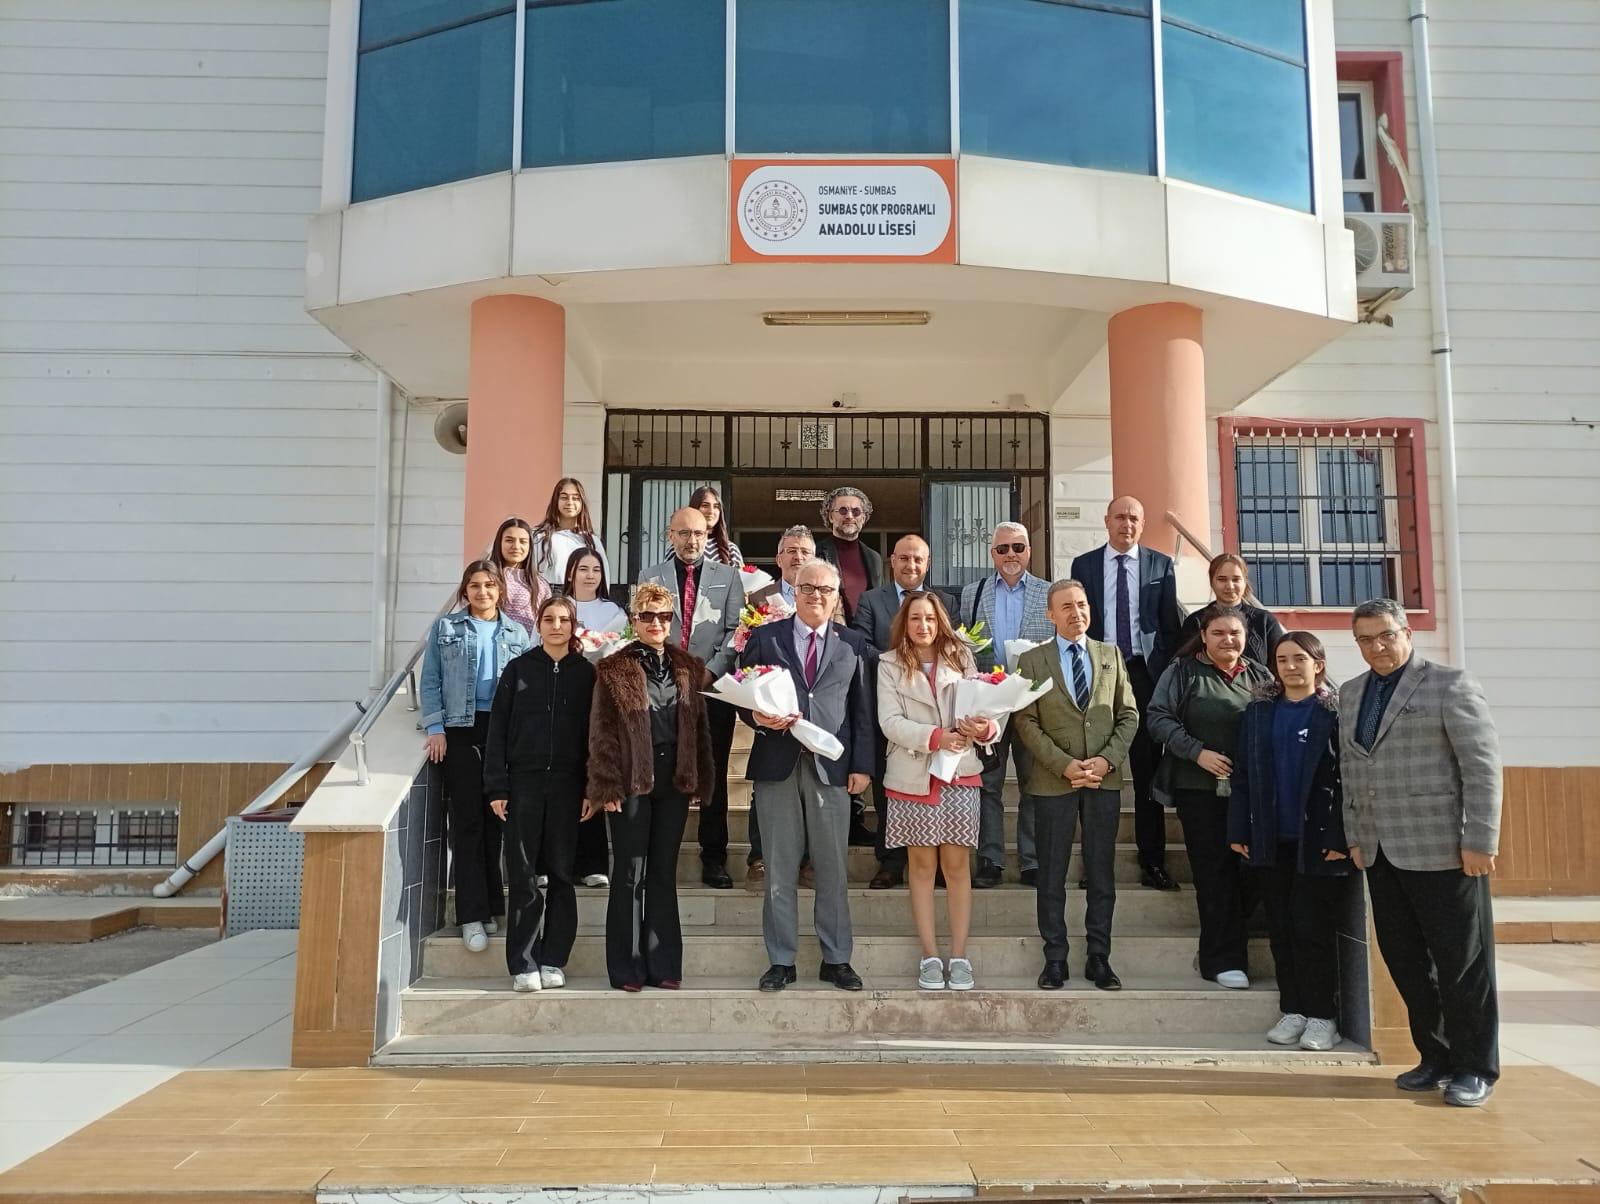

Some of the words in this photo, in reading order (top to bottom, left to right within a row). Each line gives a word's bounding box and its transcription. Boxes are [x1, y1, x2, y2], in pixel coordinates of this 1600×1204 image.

[864, 185, 897, 196] SUMBAS
[818, 203, 858, 216] SUMBAS
[859, 203, 879, 217] ÇOK
[880, 203, 936, 216] PROGRAMLI
[818, 222, 876, 236] ANADOLU
[878, 219, 916, 236] LİSESİ
